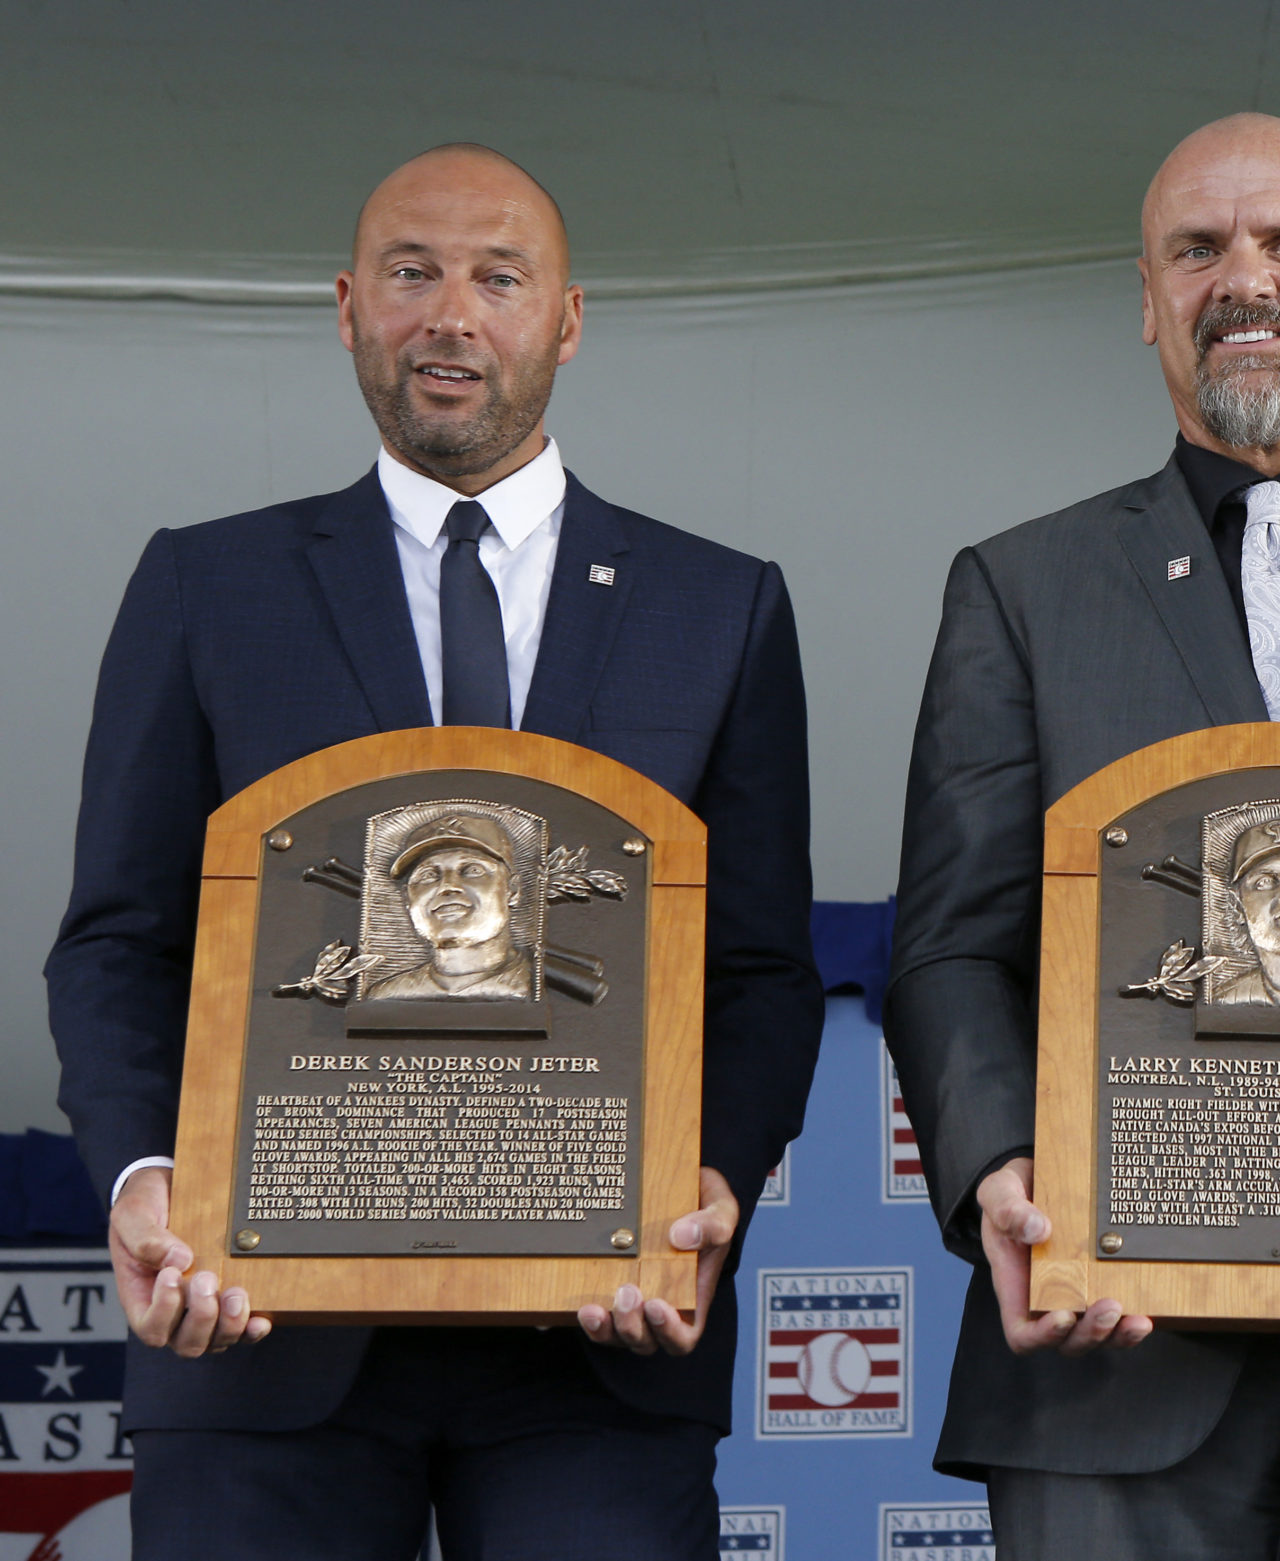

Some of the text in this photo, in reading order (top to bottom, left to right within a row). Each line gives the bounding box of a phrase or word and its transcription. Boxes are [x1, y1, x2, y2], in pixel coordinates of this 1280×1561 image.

[290, 1055, 602, 1072] DEREK SANDERSON JETER
[1110, 1056, 1180, 1072] LARRY
[1107, 1073, 1192, 1086] MONTREAL,
[1196, 1076, 1224, 1086] N.L.
[347, 1082, 542, 1094] NEW YORK, A.L. 1995-2014
[1214, 1086, 1234, 1097] ST.
[256, 1095, 629, 1108] HEARTBEAT OF A YANKEES DYNASTY. DEFINED A TWO-DECADE RUN
[1112, 1097, 1163, 1108] DYNAMIC
[1167, 1098, 1203, 1110] RIGHT
[1207, 1100, 1254, 1111] FIELDER
[255, 1106, 628, 1119] OF BRONX DOMINANCE THAT PRODUCED 17 POSTSEASON
[1112, 1120, 1152, 1131] NATIVE
[1155, 1121, 1210, 1133] CANADA'S
[1214, 1122, 1250, 1134] EXPOS
[253, 1129, 628, 1141] WORLD SERIES CHAMPIONSHIPS. SELECTED TO 14 ALL-STAR GAMES
[1111, 1154, 1156, 1166] LEAGUE
[1163, 1156, 1207, 1167] LEADER
[1214, 1157, 1227, 1168] IN
[247, 1209, 588, 1220] EARNED 2000 WORLD SERIES MOST VALUABLE PLAYER AWARD.
[1110, 1213, 1240, 1226] AND 200 STOLEN BASES.
[770, 1277, 902, 1294] NATIONAL
[769, 1312, 901, 1328] BASEBALL
[767, 1410, 900, 1427] HALL OF FAME
[891, 1511, 991, 1529] NATION
